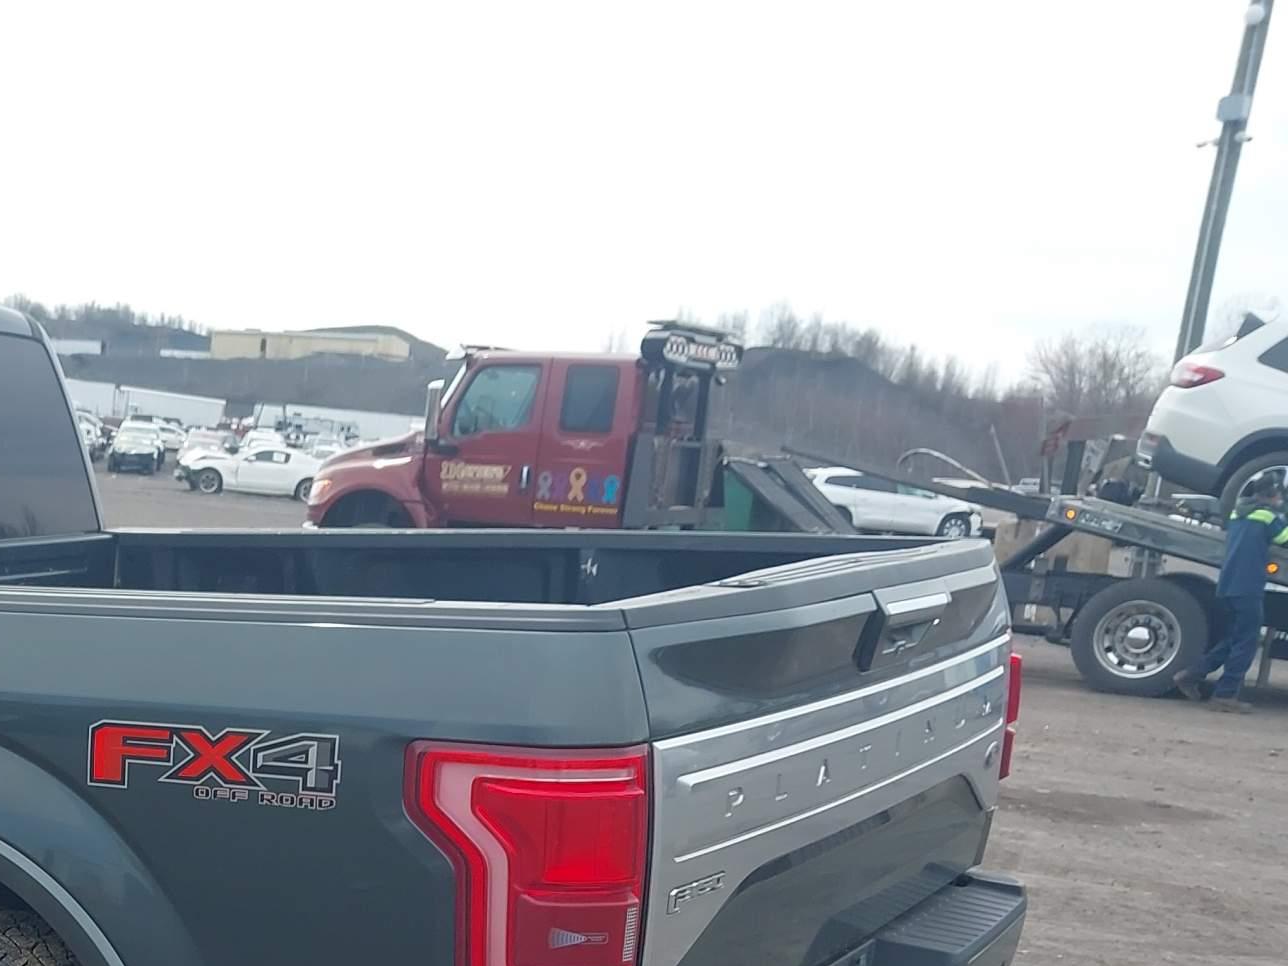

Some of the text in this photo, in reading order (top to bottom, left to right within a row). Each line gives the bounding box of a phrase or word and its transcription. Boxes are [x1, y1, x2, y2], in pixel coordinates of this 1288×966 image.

[87, 719, 342, 796] FX4
[193, 786, 337, 811] OFF ROAD
